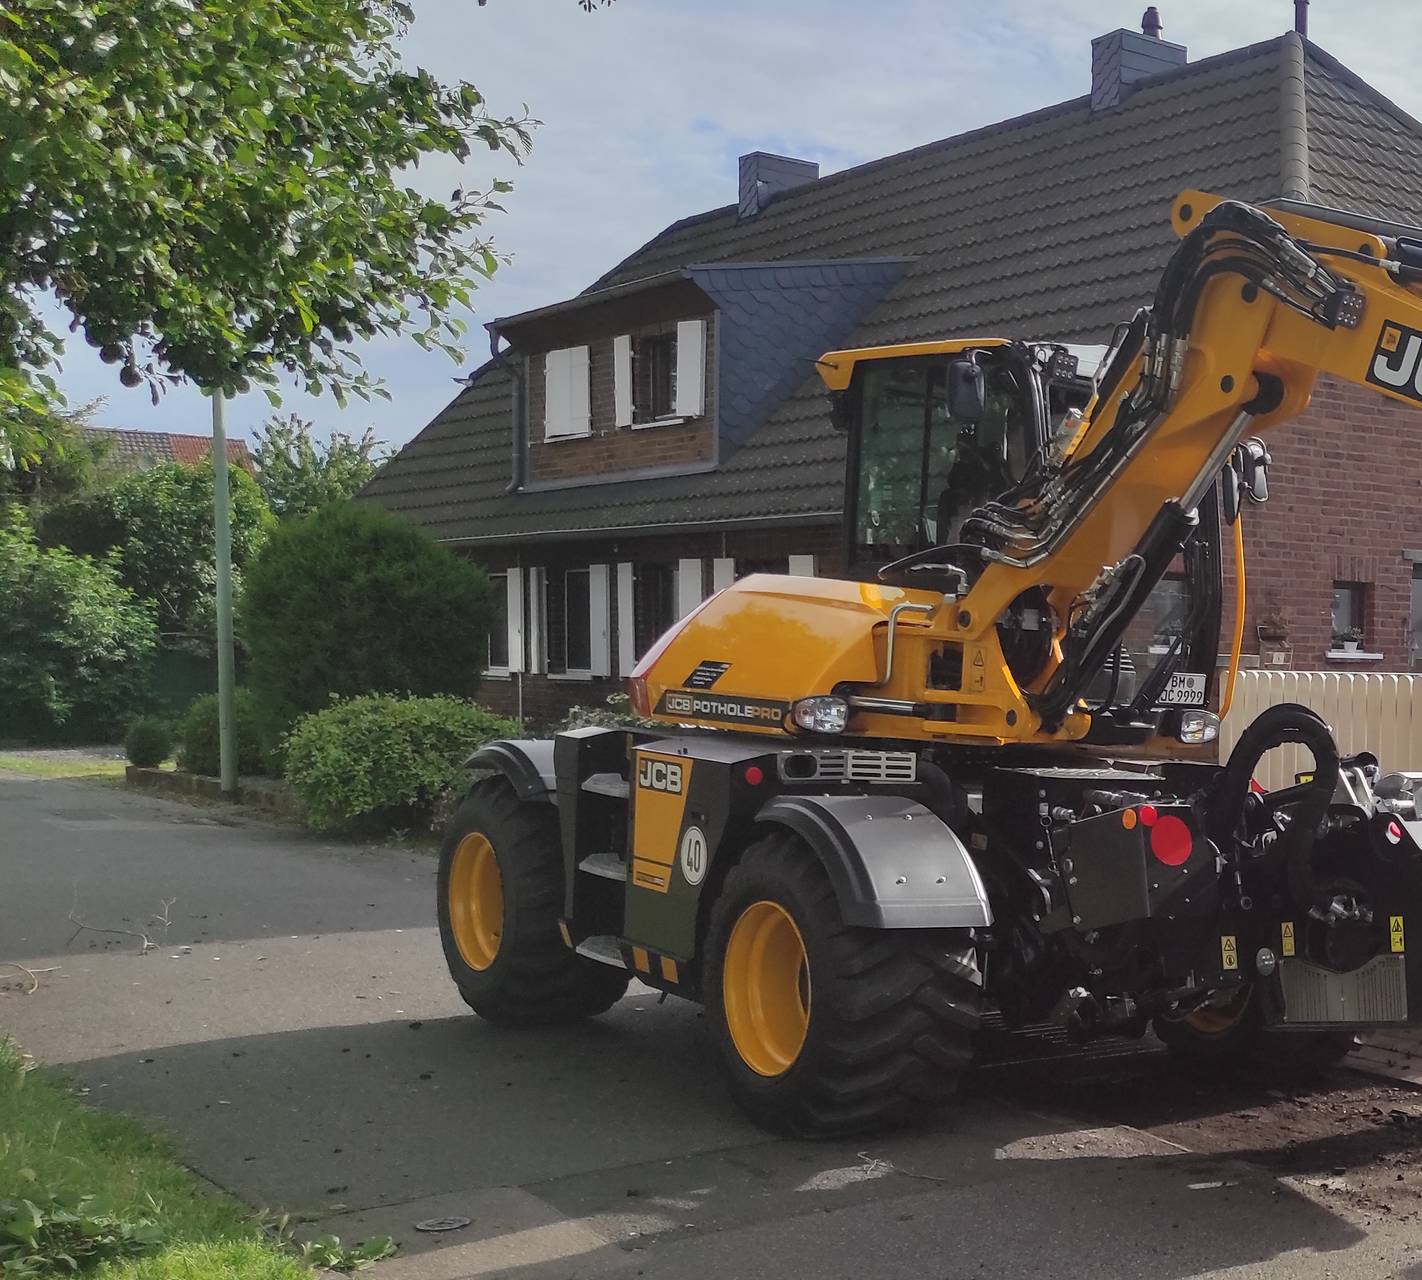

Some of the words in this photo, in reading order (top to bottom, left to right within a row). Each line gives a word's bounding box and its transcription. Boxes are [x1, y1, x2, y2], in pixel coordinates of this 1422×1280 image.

[1171, 676, 1186, 688] BM
[1177, 689, 1203, 703] 9999
[667, 697, 691, 711] JCB
[640, 760, 682, 793] JCB
[686, 838, 701, 873] 40
